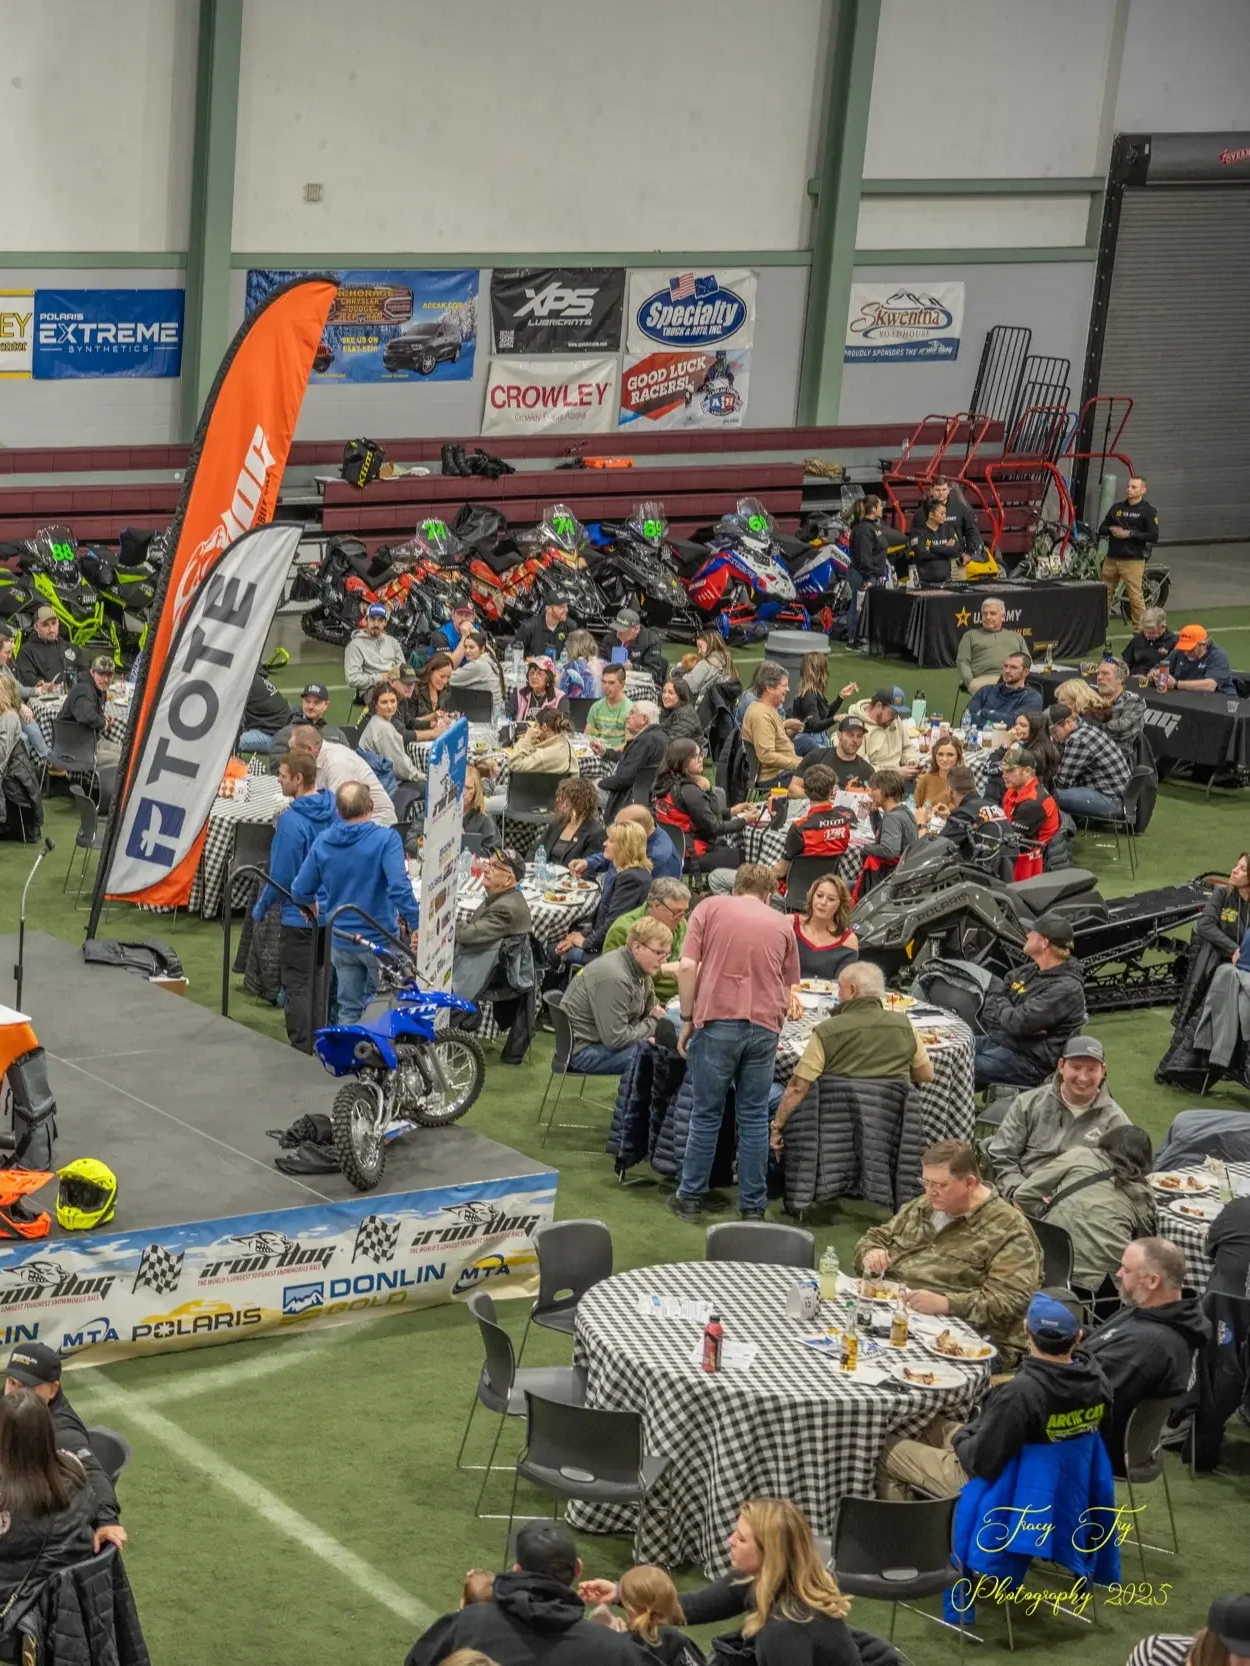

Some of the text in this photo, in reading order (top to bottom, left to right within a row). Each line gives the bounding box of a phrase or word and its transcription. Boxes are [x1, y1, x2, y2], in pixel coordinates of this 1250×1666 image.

[336, 289, 394, 298] NCHORAGE
[513, 282, 600, 317] XPS
[40, 313, 85, 322] POLARIS
[527, 318, 593, 326] LUBRICANTS
[646, 299, 739, 328] Specialty
[39, 322, 179, 344] EXTREME
[662, 327, 684, 337] TRUCK
[68, 345, 149, 354] SYNTHETICS
[872, 347, 904, 357] SPONSORS
[905, 347, 917, 356] THE
[627, 355, 706, 392] GOOD LUCK
[490, 383, 609, 410] CROWLEY
[630, 376, 691, 406] RACERS!
[52, 543, 75, 562] 88
[146, 569, 259, 787] TOTE
[411, 1211, 541, 1248] iron dog
[200, 1242, 337, 1277] iron dog
[210, 1275, 231, 1285] WORLD'S
[231, 1273, 251, 1282] LONGEST
[330, 1262, 447, 1299] DONLIN
[460, 1264, 511, 1281] MTA
[50, 1273, 116, 1301] dog
[0, 1305, 23, 1314] LONGEST
[23, 1300, 51, 1310] TOUGHEST
[87, 1294, 99, 1302] RACE
[131, 1307, 262, 1342] POLARIS
[63, 1327, 119, 1348] MTA
[1046, 1402, 1105, 1428] ARCTIC CAT
